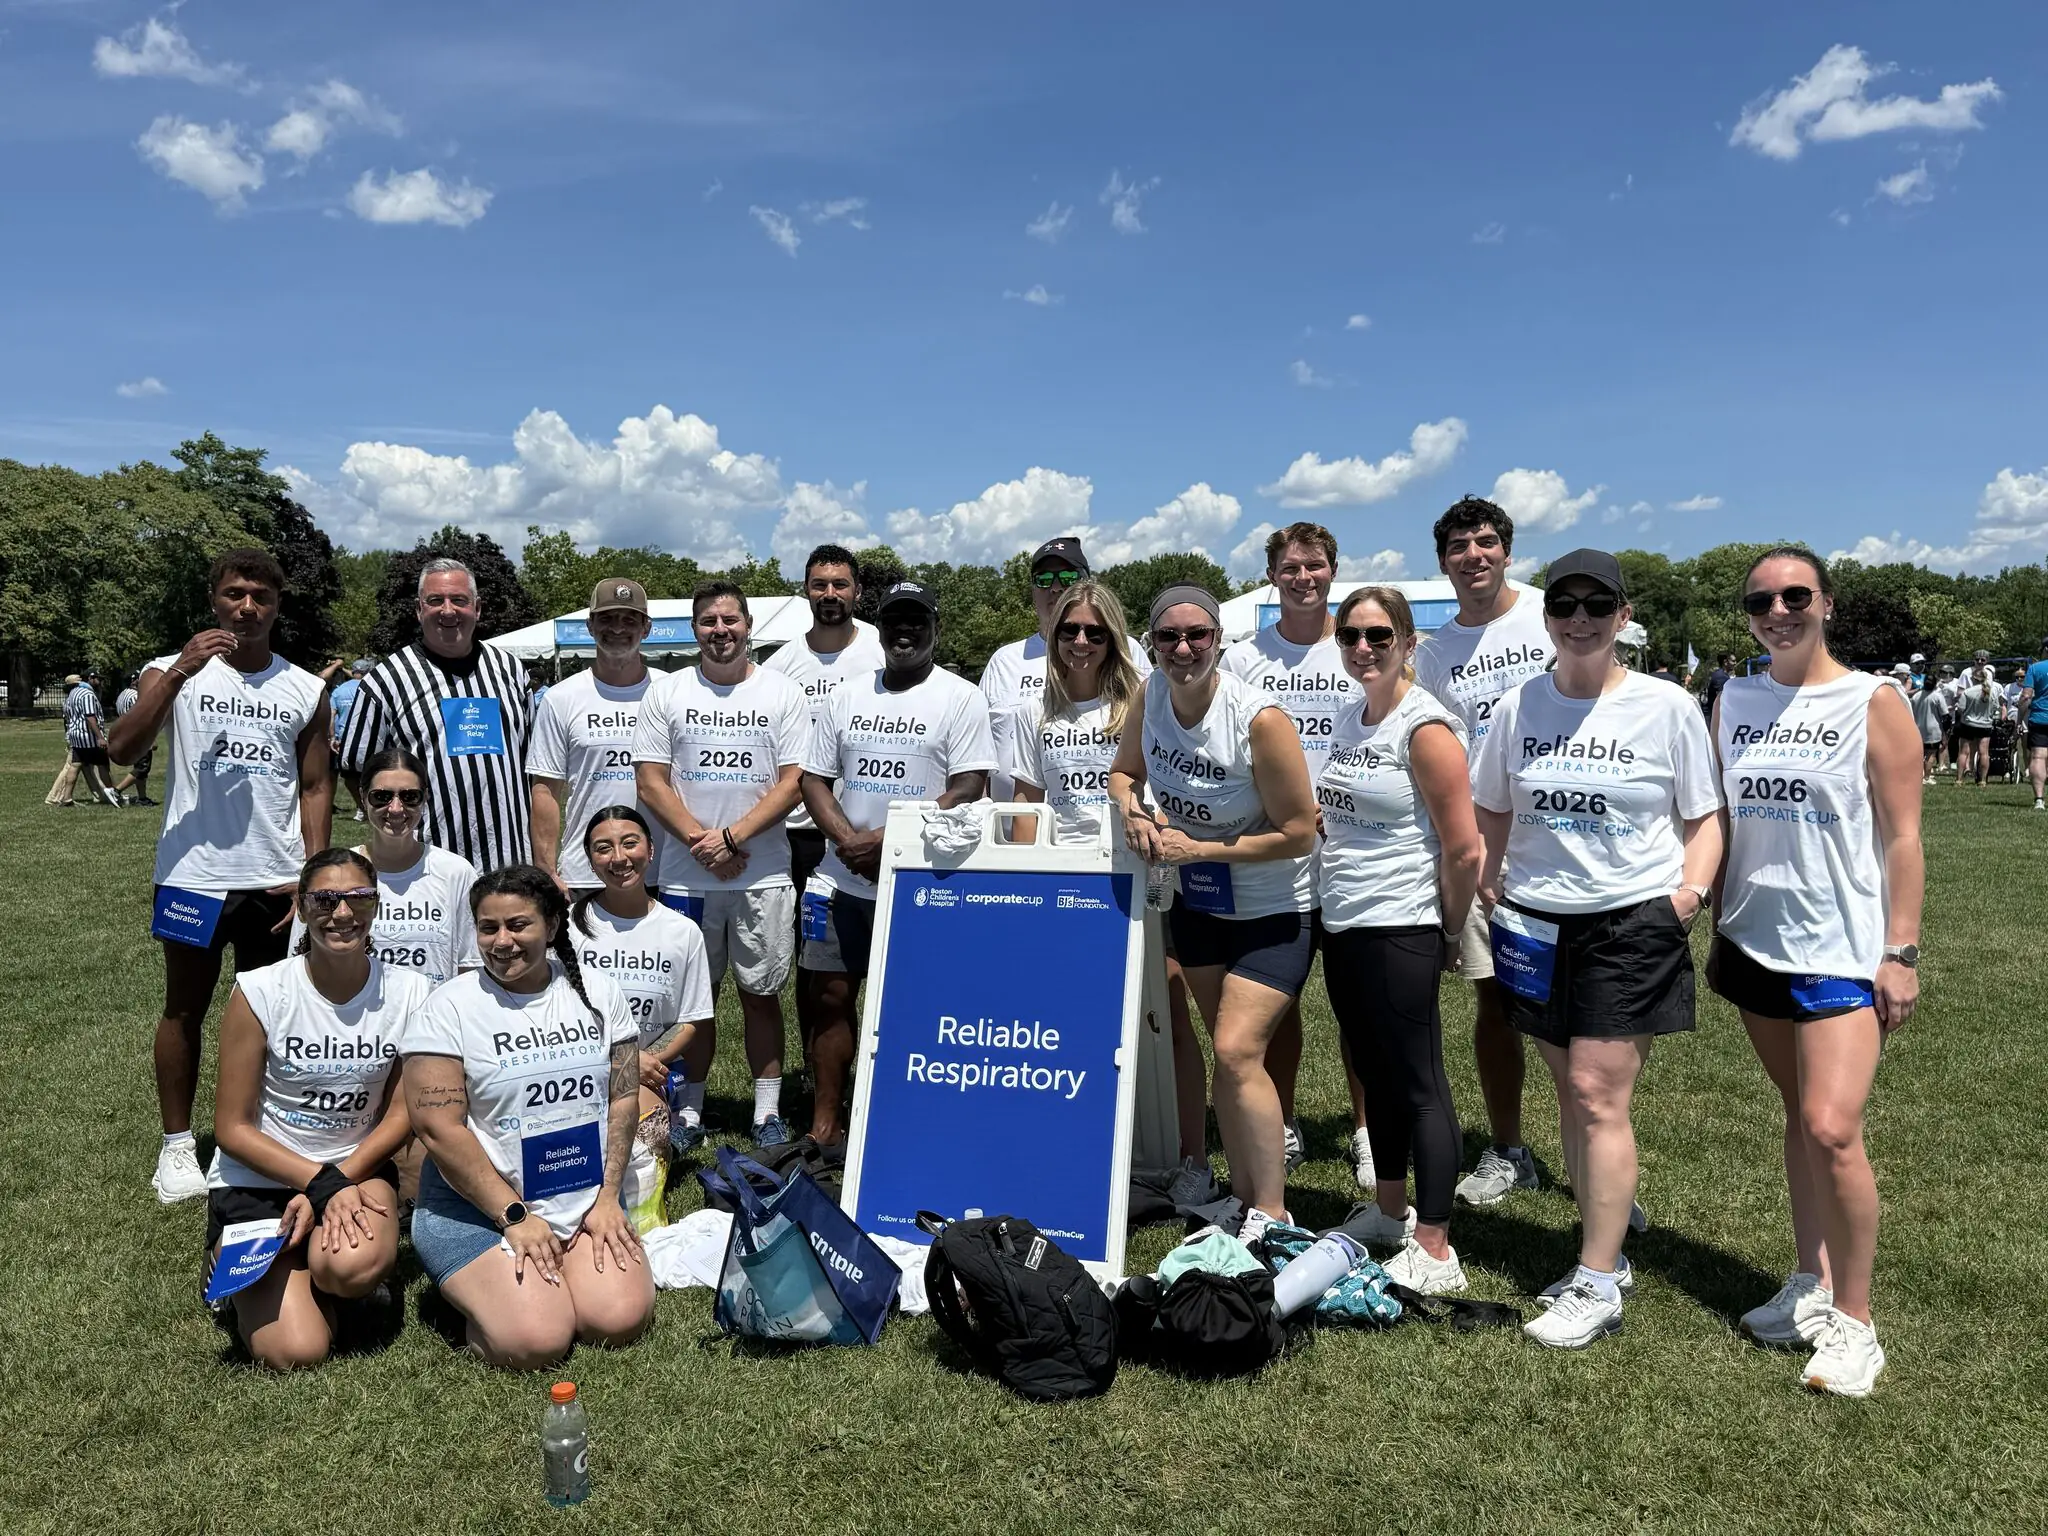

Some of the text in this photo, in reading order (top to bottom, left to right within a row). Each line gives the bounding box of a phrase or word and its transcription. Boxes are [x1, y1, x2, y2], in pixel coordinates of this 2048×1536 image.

[652, 626, 676, 638] Party
[1450, 644, 1544, 683] Reliable
[1263, 673, 1349, 692] Reliable
[1456, 664, 1545, 693] RESPIRATORY
[200, 694, 291, 724] Reliable
[686, 708, 769, 727] Reliable
[849, 715, 926, 735] Reliable
[1731, 722, 1840, 747] Reliable
[214, 739, 273, 761] 2026
[699, 751, 753, 768] 2026
[1151, 737, 1226, 781] Reliable
[1522, 735, 1634, 764] Reliable
[1731, 748, 1836, 760] RESPIRATORY
[192, 760, 268, 776] CORPORATE
[681, 771, 770, 783] CORPORATE CUP
[857, 758, 906, 779] 2026
[1520, 761, 1631, 776] RESPIRATORY
[903, 784, 926, 795] CUP
[1060, 771, 1109, 791] 2026
[1739, 776, 1807, 802] 2026
[1160, 791, 1212, 821] 2026
[1316, 786, 1355, 812] 2026
[1532, 789, 1607, 815] 2026
[1805, 811, 1840, 825] CUP
[1605, 823, 1634, 837] CUP
[171, 901, 200, 915] Reliable
[966, 894, 1043, 906] corporatecup
[163, 908, 203, 926] Respiratory
[583, 949, 671, 973] Reliable
[1501, 944, 1530, 962] Reliable
[1496, 952, 1537, 976] Respiratory
[493, 1019, 600, 1056] Reliable
[937, 1016, 1060, 1050] Reliable
[285, 1035, 397, 1059] Reliable
[499, 1044, 603, 1069] RESPIRATORY
[906, 1053, 1086, 1099] Respiratory
[299, 1090, 370, 1112] 2026
[525, 1075, 594, 1107] 2026
[545, 1145, 580, 1160] Reliable
[538, 1155, 588, 1173] Respiratory
[877, 1214, 898, 1222] Follow
[810, 1231, 864, 1284] aldi.us
